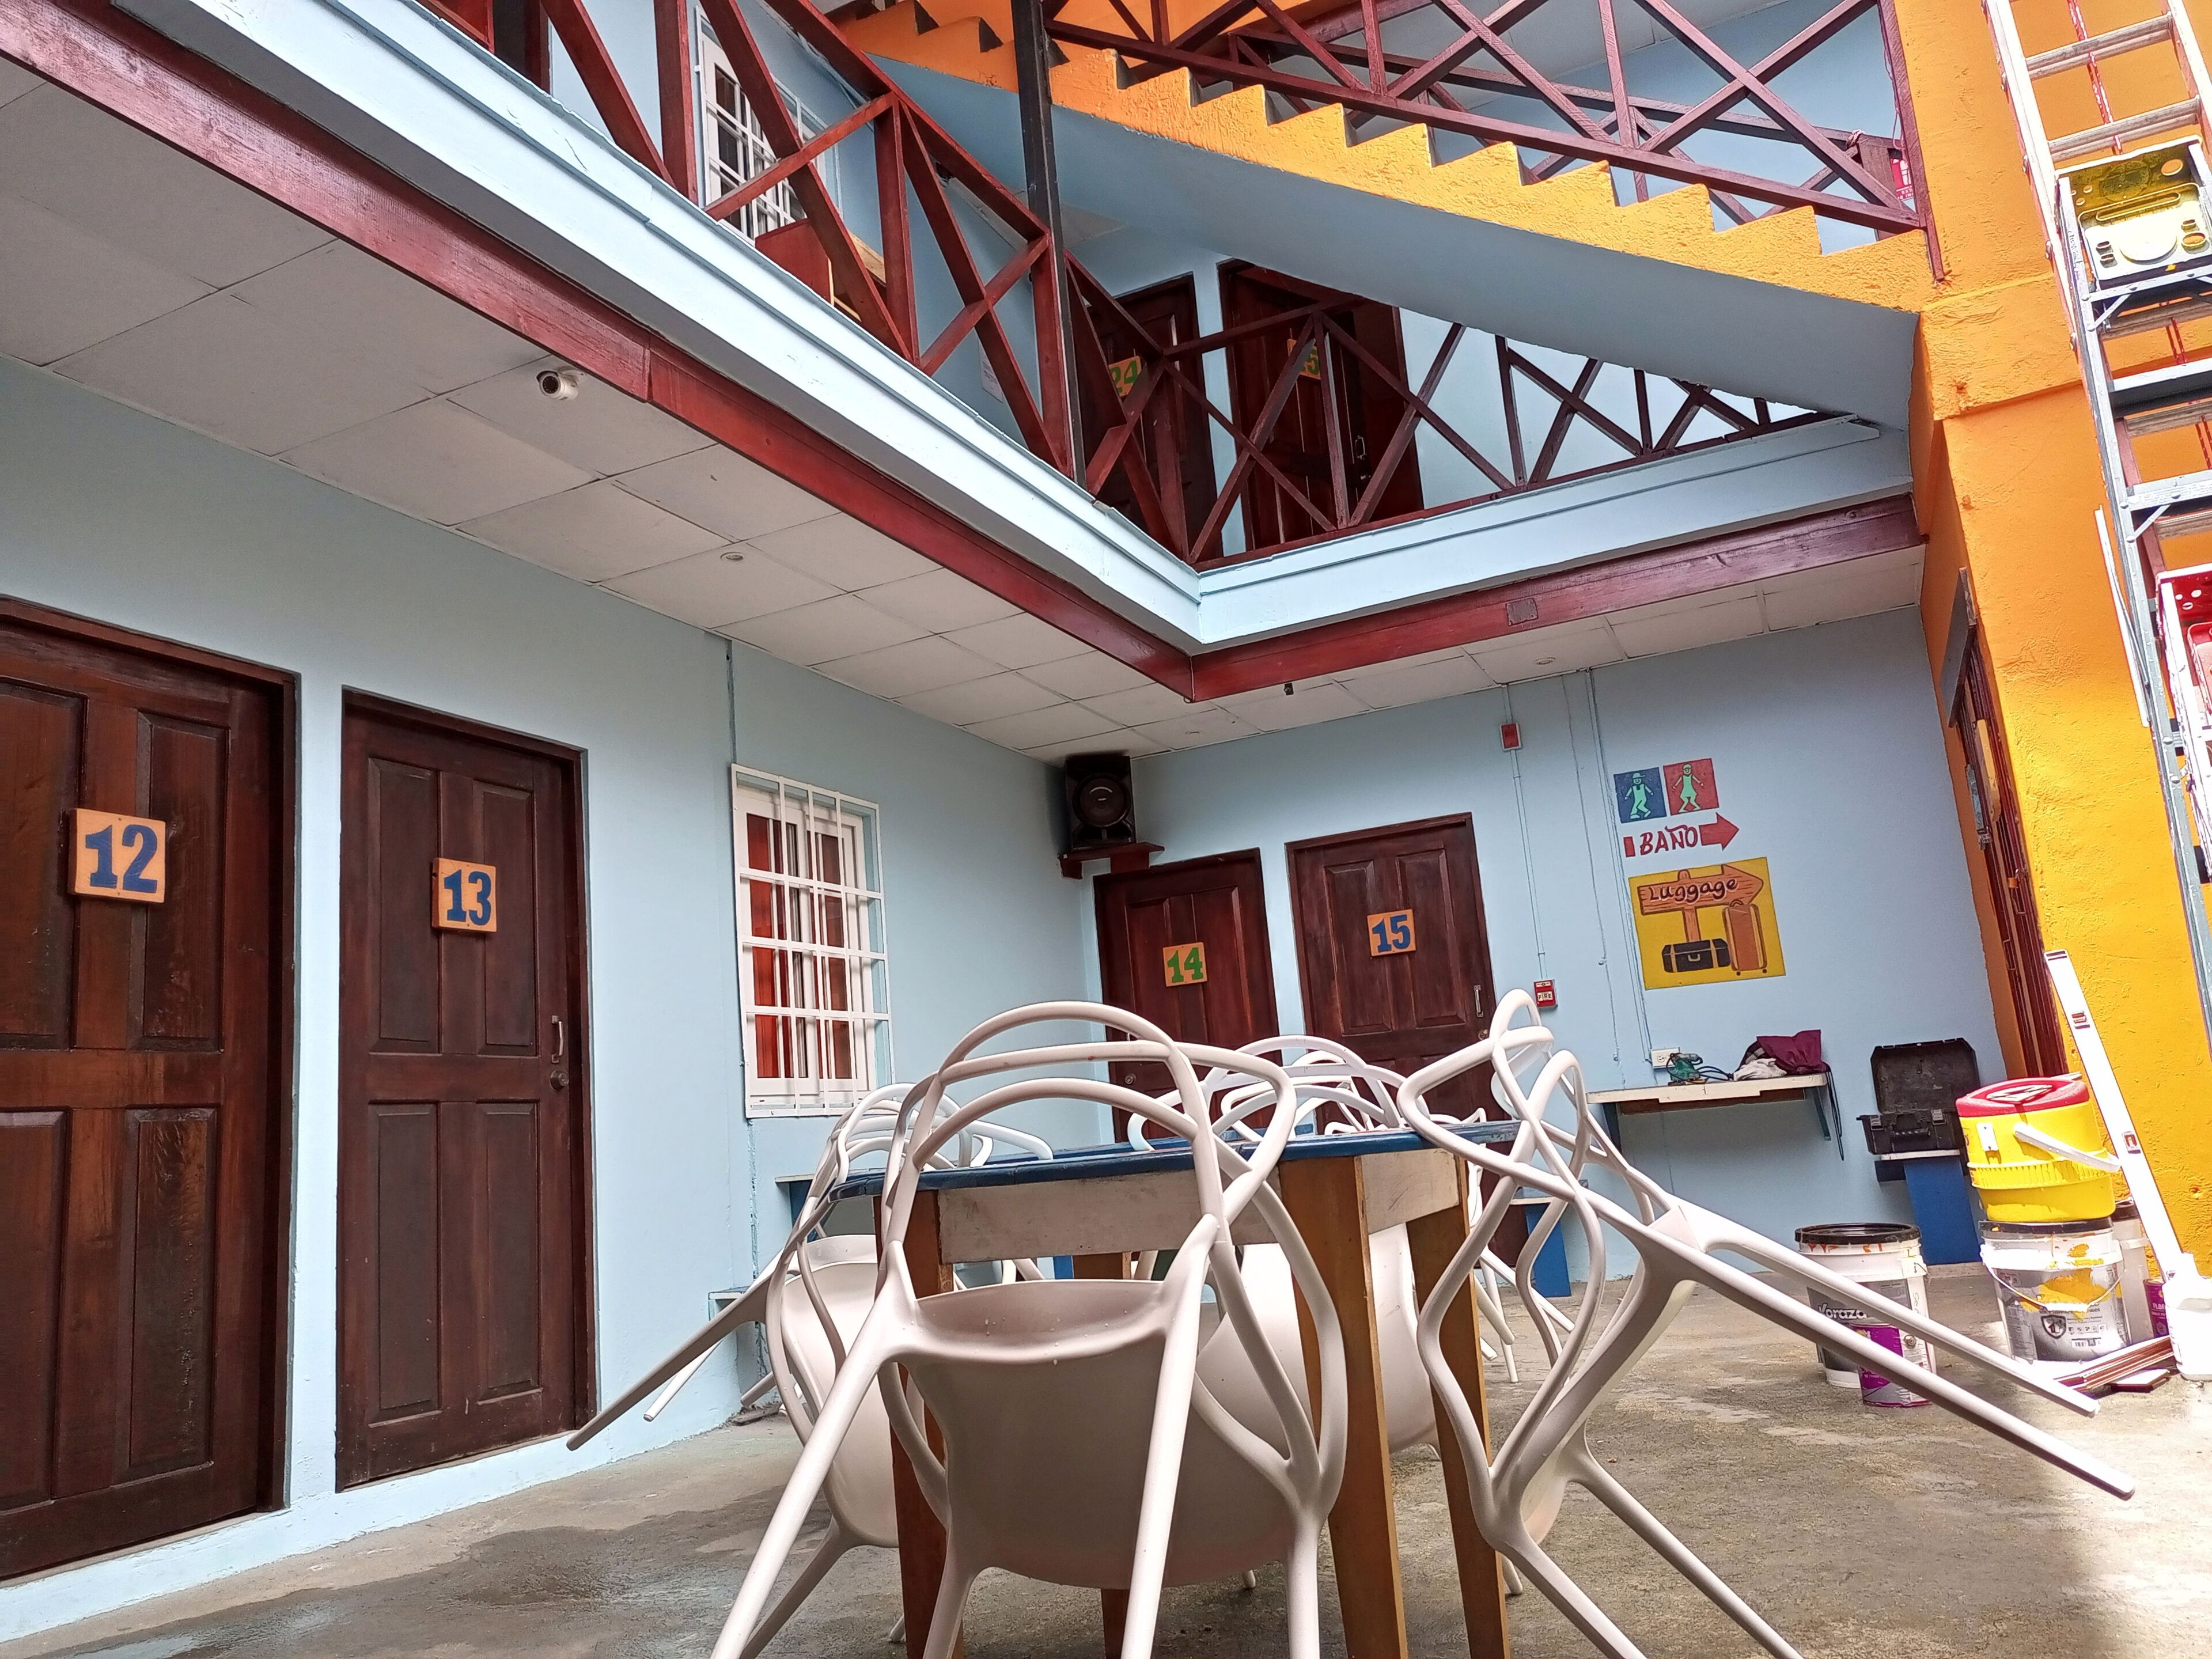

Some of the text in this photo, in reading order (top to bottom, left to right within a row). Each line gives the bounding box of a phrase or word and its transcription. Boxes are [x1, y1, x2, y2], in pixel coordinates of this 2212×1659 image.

[85, 824, 158, 893] 12
[1639, 824, 1698, 856] BAÑO
[444, 869, 491, 926] 13
[1648, 878, 1738, 904] Luggage
[1372, 914, 1411, 953] 15
[1166, 946, 1204, 983] 14
